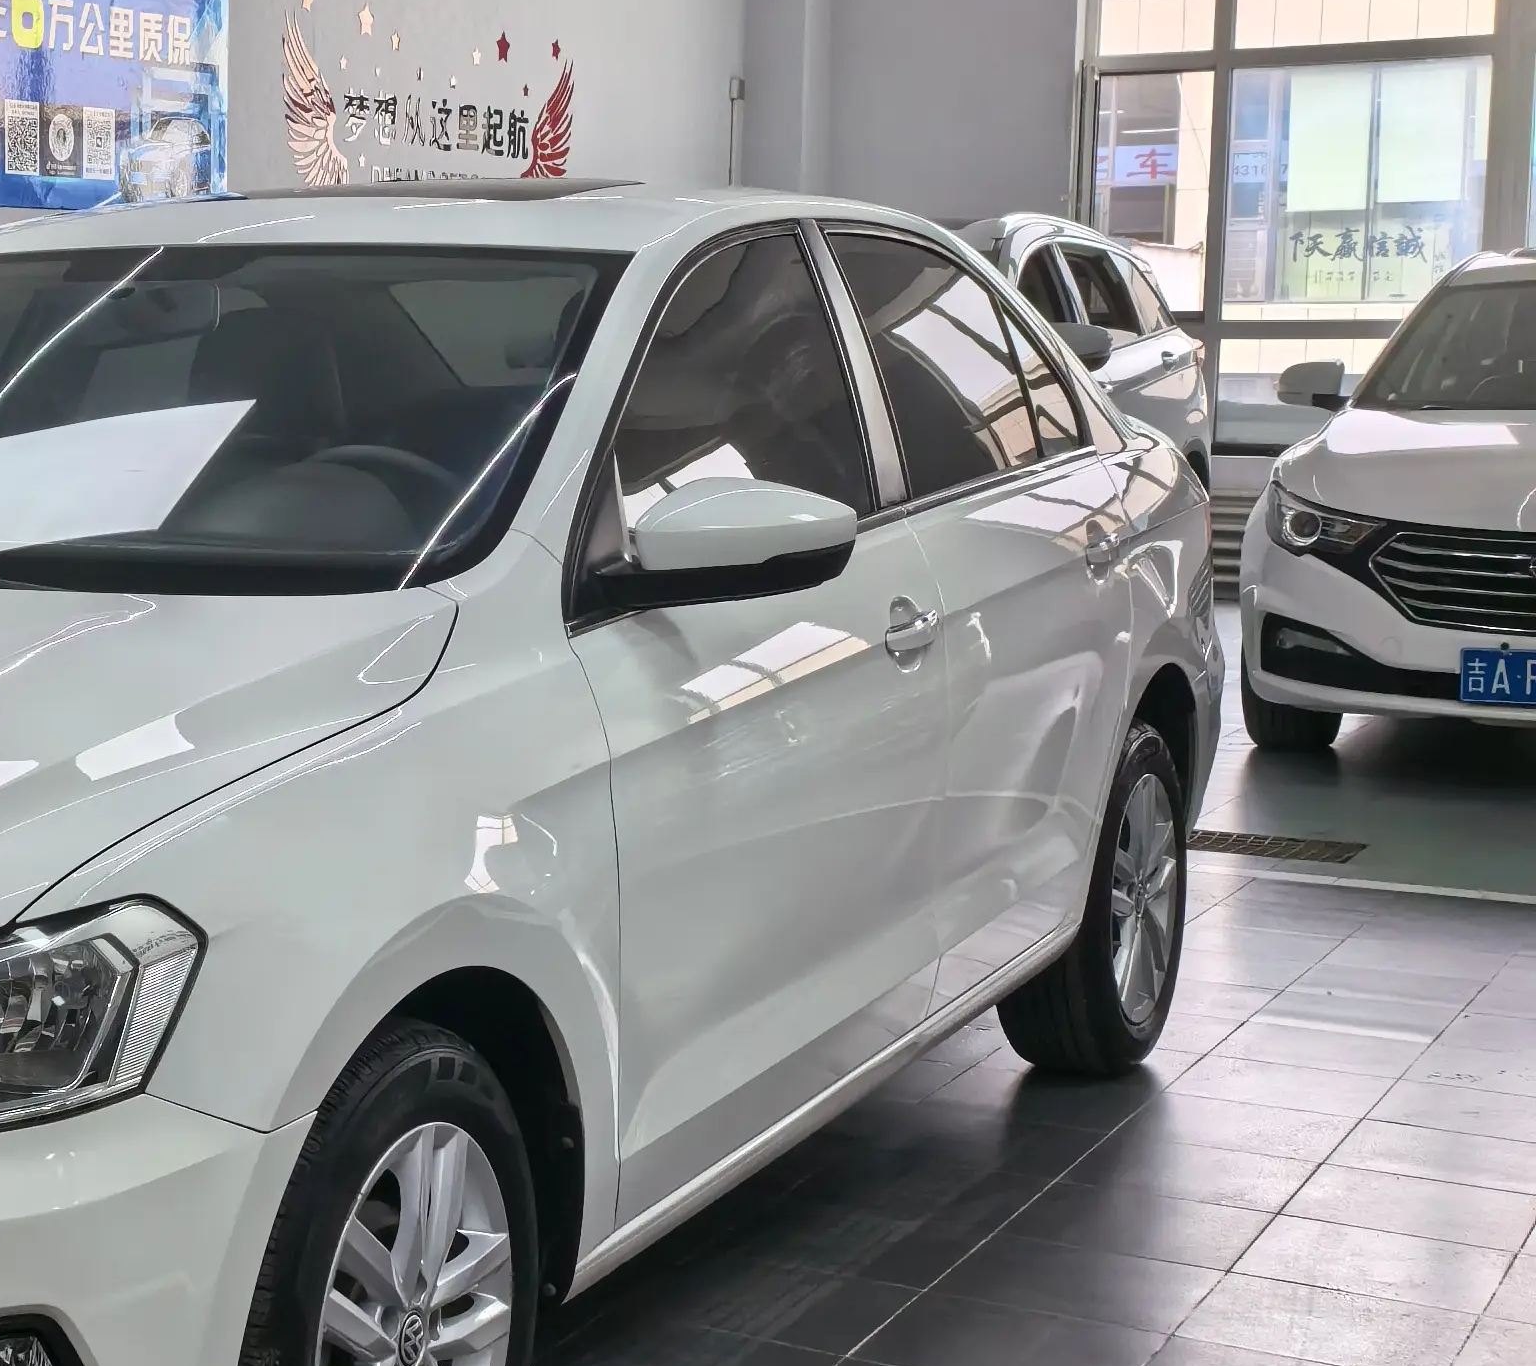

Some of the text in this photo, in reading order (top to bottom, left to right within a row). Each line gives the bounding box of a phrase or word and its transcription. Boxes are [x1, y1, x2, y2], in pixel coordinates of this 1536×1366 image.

[343, 86, 530, 160] 梦想从这里起航
